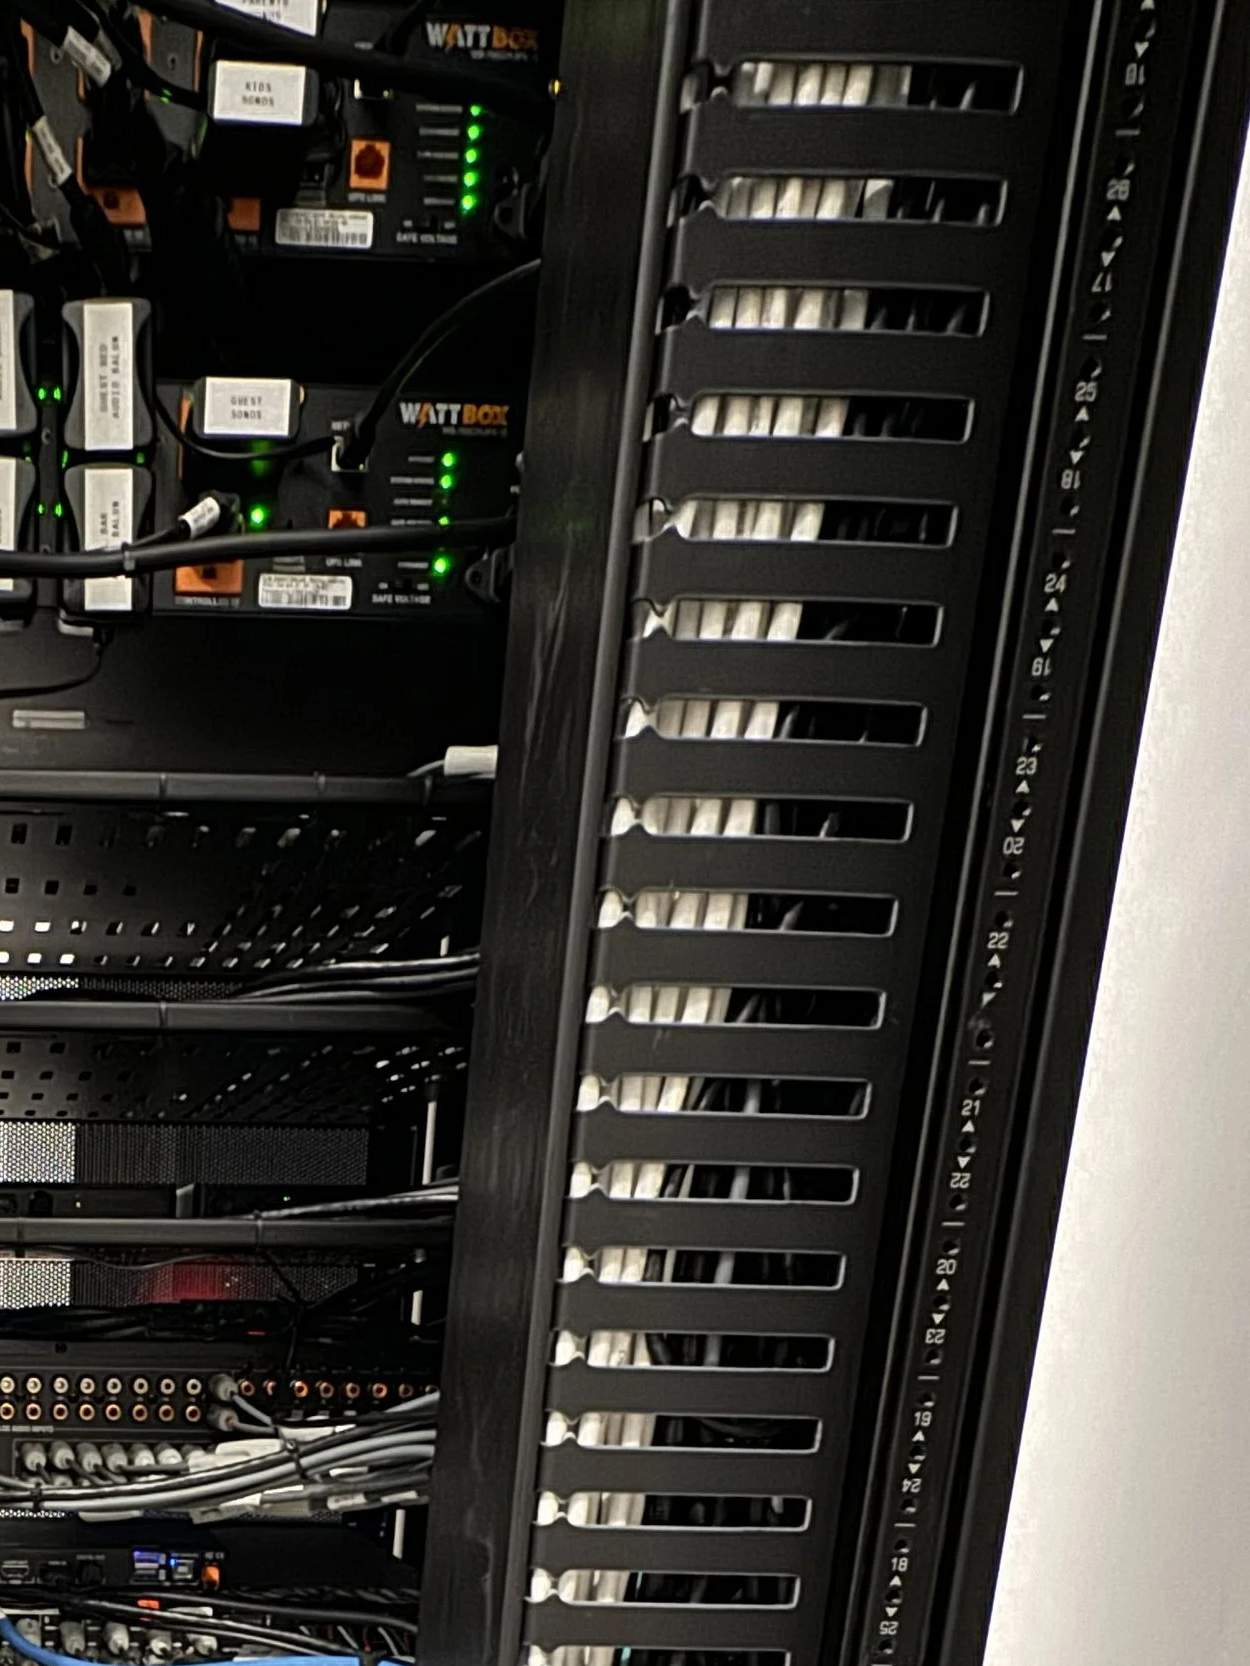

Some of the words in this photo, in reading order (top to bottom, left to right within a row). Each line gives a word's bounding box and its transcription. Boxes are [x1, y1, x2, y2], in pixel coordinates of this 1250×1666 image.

[1075, 382, 1097, 401] 25
[1045, 574, 1067, 592] 24
[1016, 757, 1037, 775] 23
[988, 933, 1009, 949] 22
[961, 1100, 980, 1115] 21
[936, 1259, 957, 1275] 20
[914, 1412, 932, 1427] 19
[891, 1557, 908, 1571] 18
